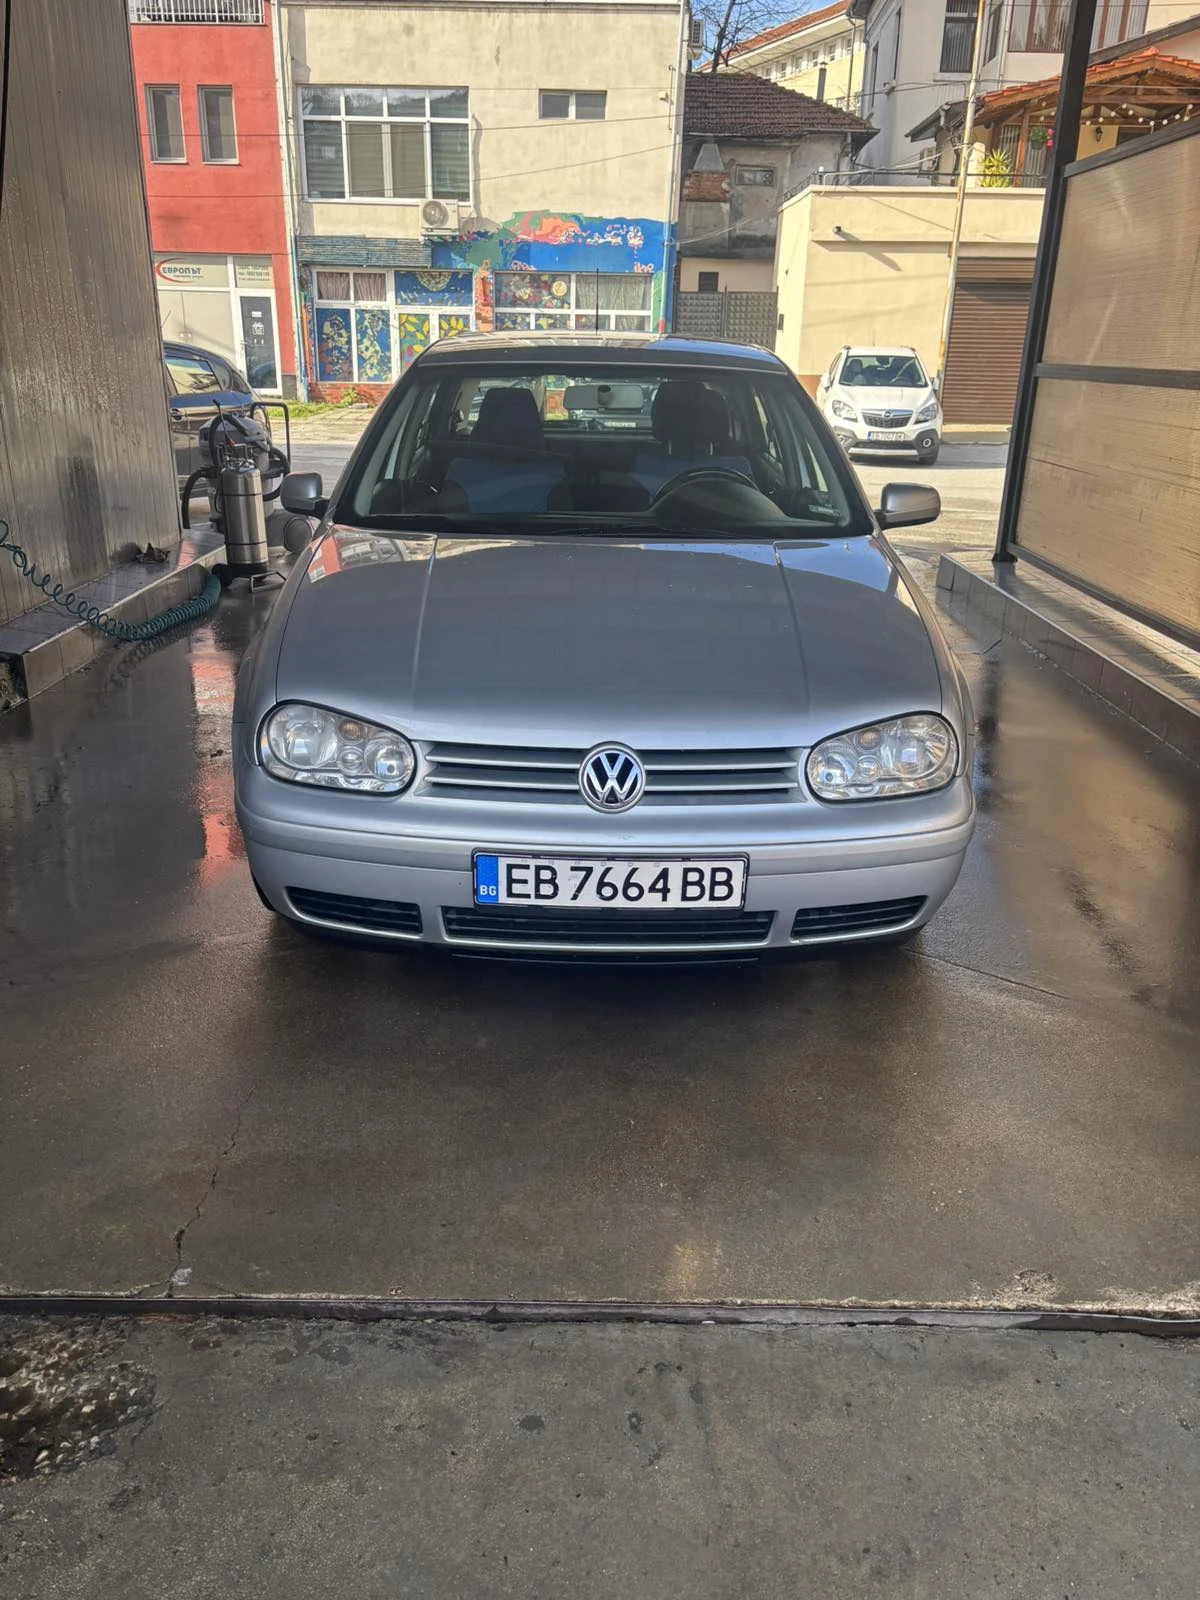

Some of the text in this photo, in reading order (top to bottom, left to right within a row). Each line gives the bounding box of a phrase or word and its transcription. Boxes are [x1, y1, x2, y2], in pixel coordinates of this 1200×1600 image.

[162, 266, 202, 275] ЕВРОПЪТ
[584, 750, 640, 805] VW
[479, 885, 497, 896] BG
[505, 863, 734, 903] EB 7664 BB
